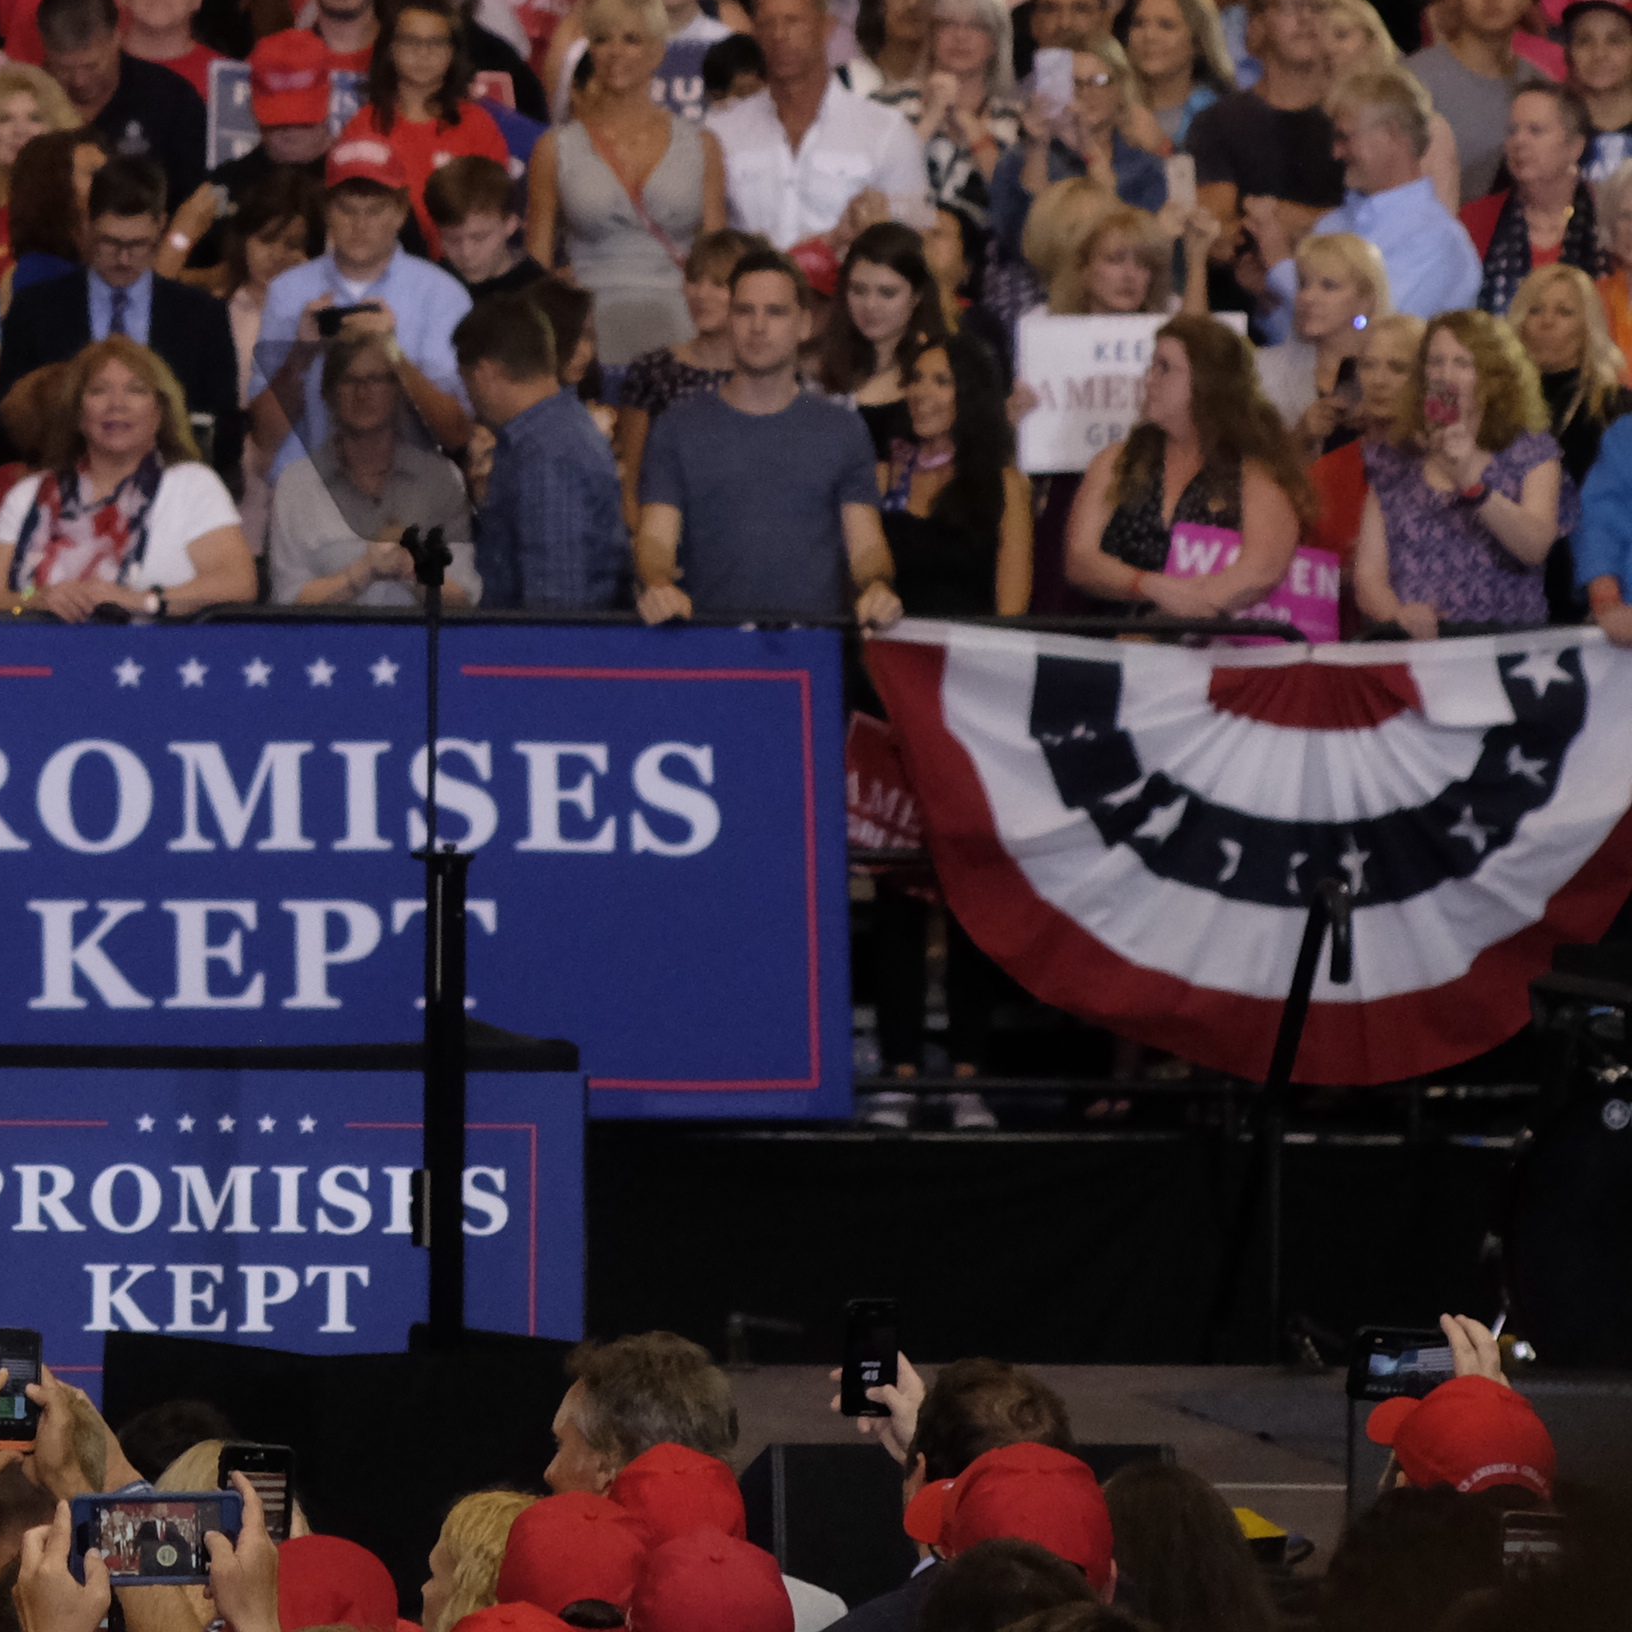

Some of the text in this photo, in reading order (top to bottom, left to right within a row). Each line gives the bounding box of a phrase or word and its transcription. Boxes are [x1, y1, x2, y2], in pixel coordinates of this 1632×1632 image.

[1092, 340, 1146, 364] KEE
[27, 899, 499, 1010] KEPT
[83, 1263, 371, 1334] KEPT
